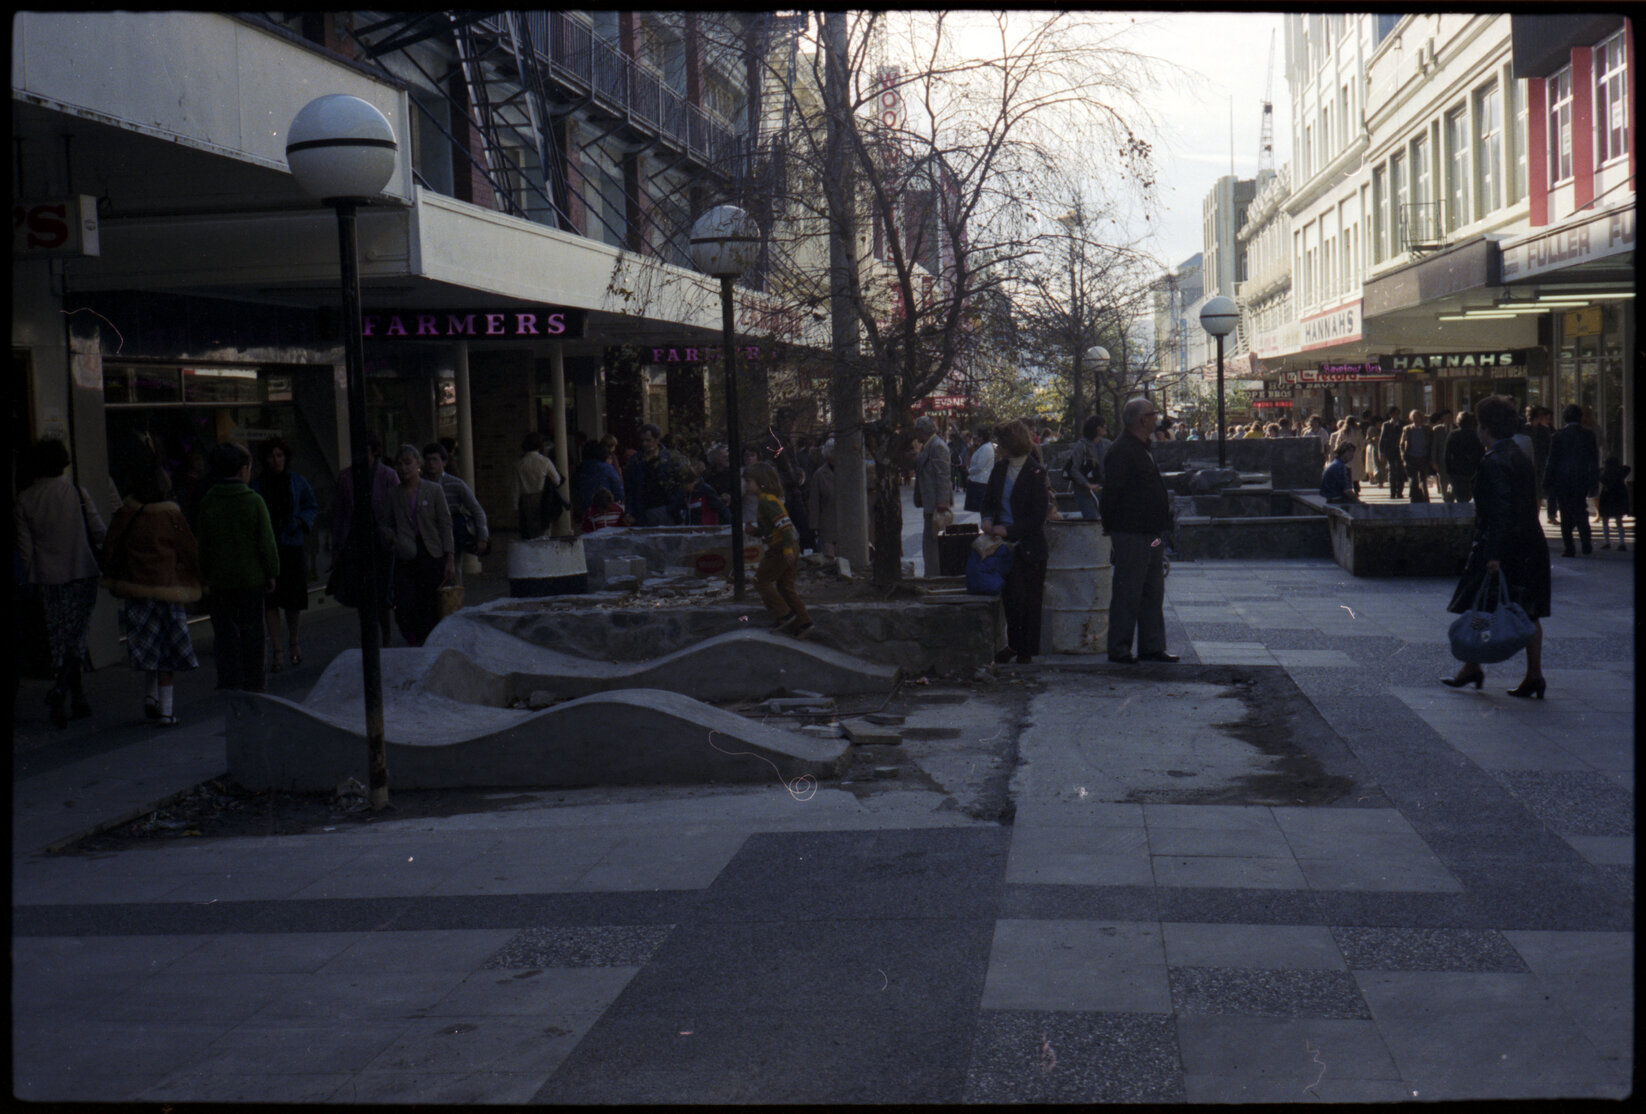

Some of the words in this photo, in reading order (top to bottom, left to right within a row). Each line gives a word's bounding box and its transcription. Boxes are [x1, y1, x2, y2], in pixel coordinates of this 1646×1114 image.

[1527, 224, 1591, 270] FULLER
[362, 313, 567, 336] FARMERS
[1305, 310, 1354, 343] HANNAHS
[1393, 353, 1512, 369] HANNAHS
